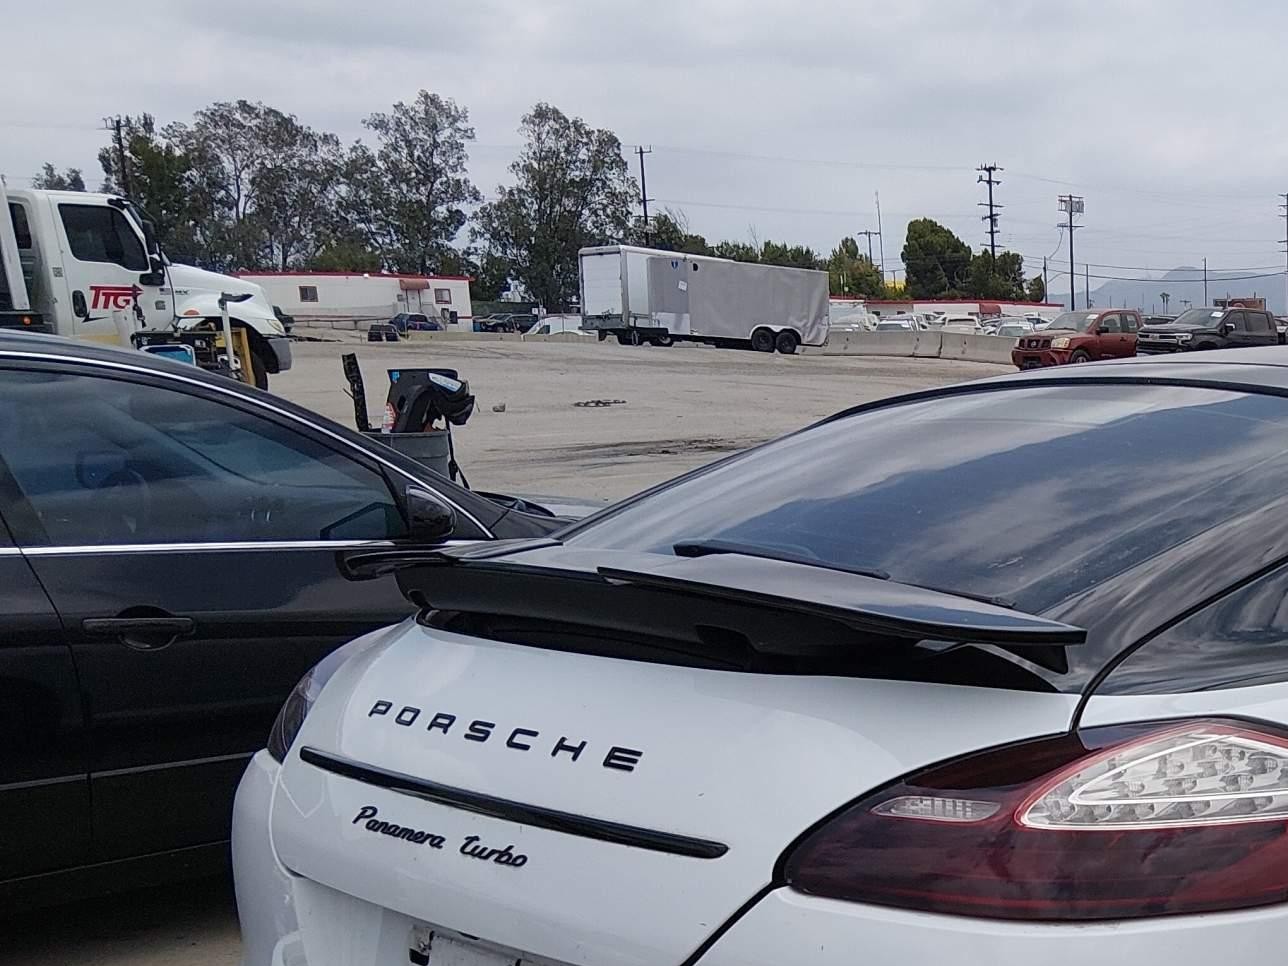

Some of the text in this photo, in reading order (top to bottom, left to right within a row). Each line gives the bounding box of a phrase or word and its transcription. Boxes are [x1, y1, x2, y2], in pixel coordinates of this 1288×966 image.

[368, 700, 643, 772] PORSCHE
[352, 806, 528, 868] Panamera turbo
